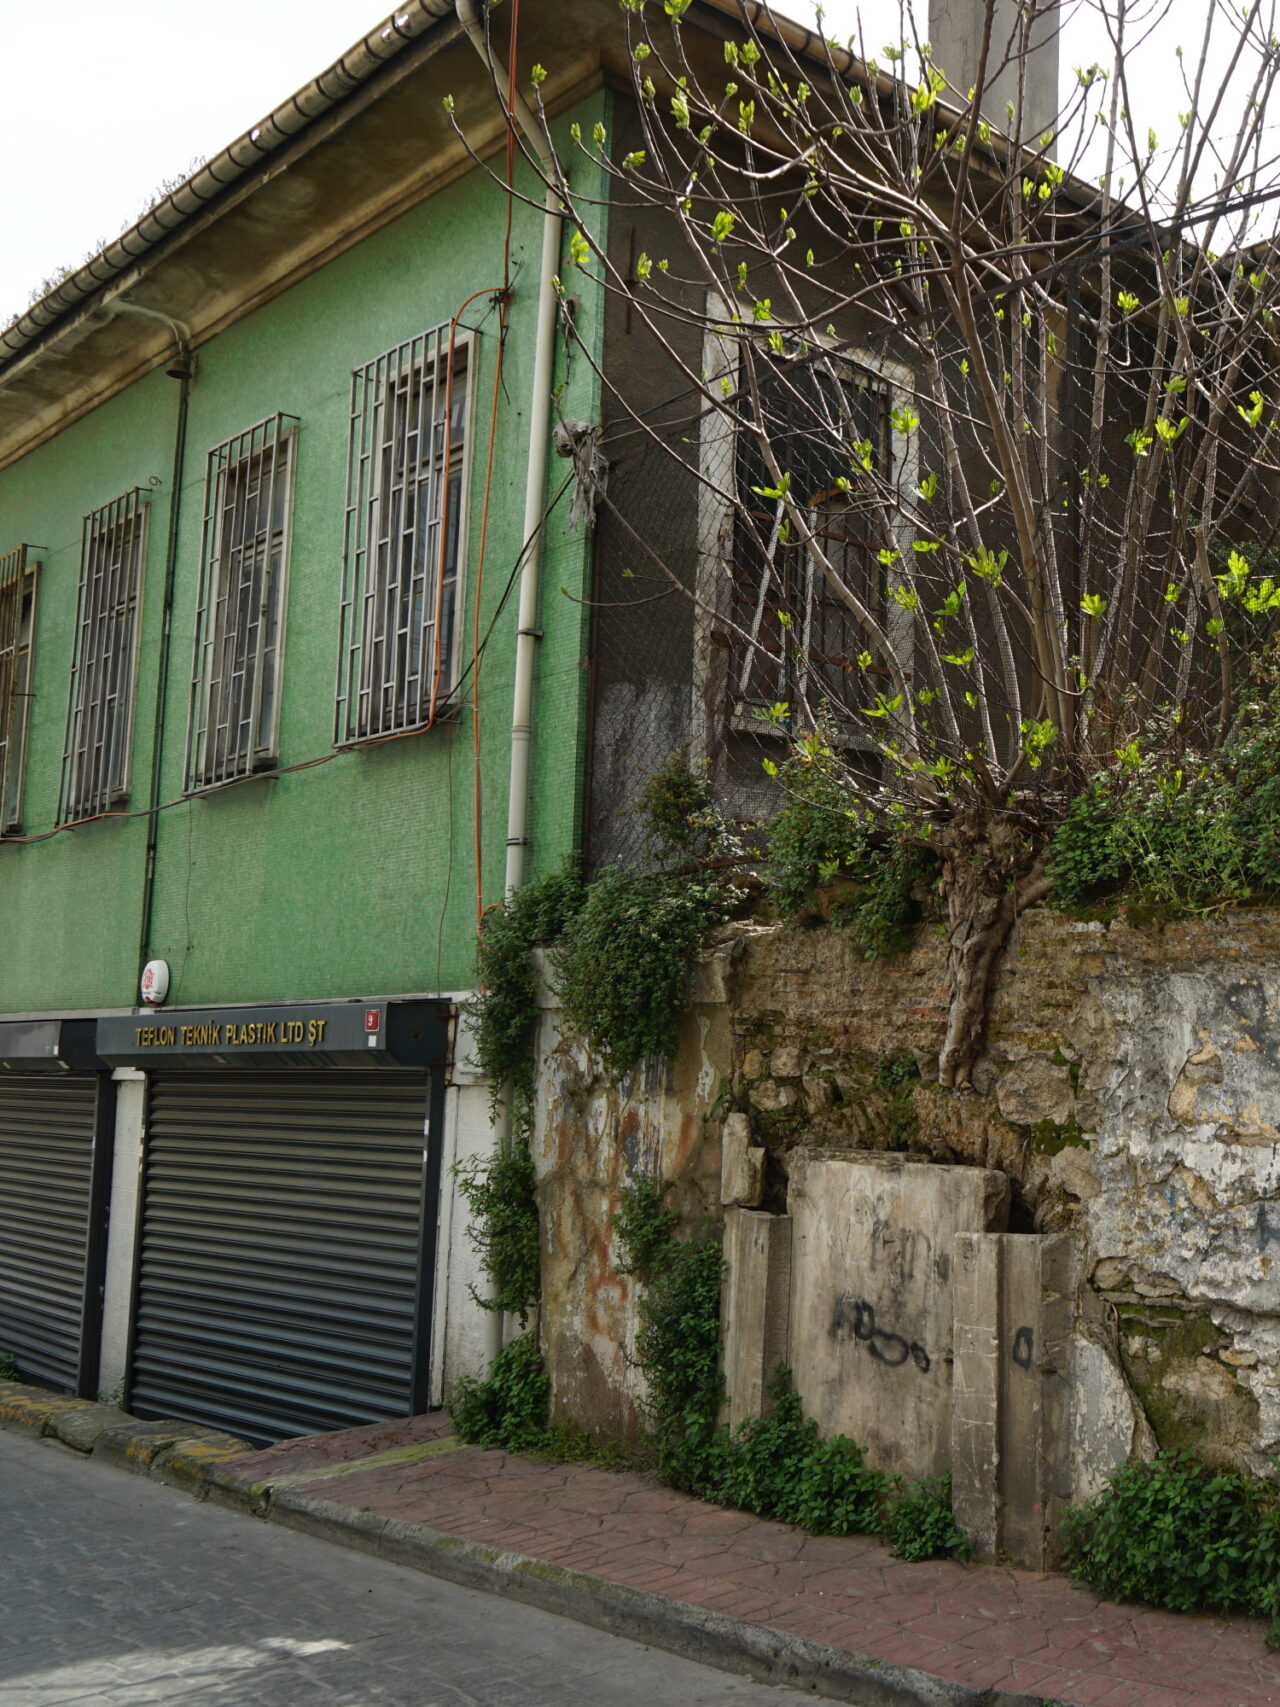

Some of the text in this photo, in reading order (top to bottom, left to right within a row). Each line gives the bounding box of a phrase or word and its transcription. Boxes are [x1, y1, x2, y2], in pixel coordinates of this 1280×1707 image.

[367, 1014, 374, 1027] 9
[135, 1027, 175, 1047] TEFLON
[180, 1019, 222, 1046] TEKNİK
[280, 1021, 304, 1043] LTD
[308, 1020, 327, 1046] ŞT
